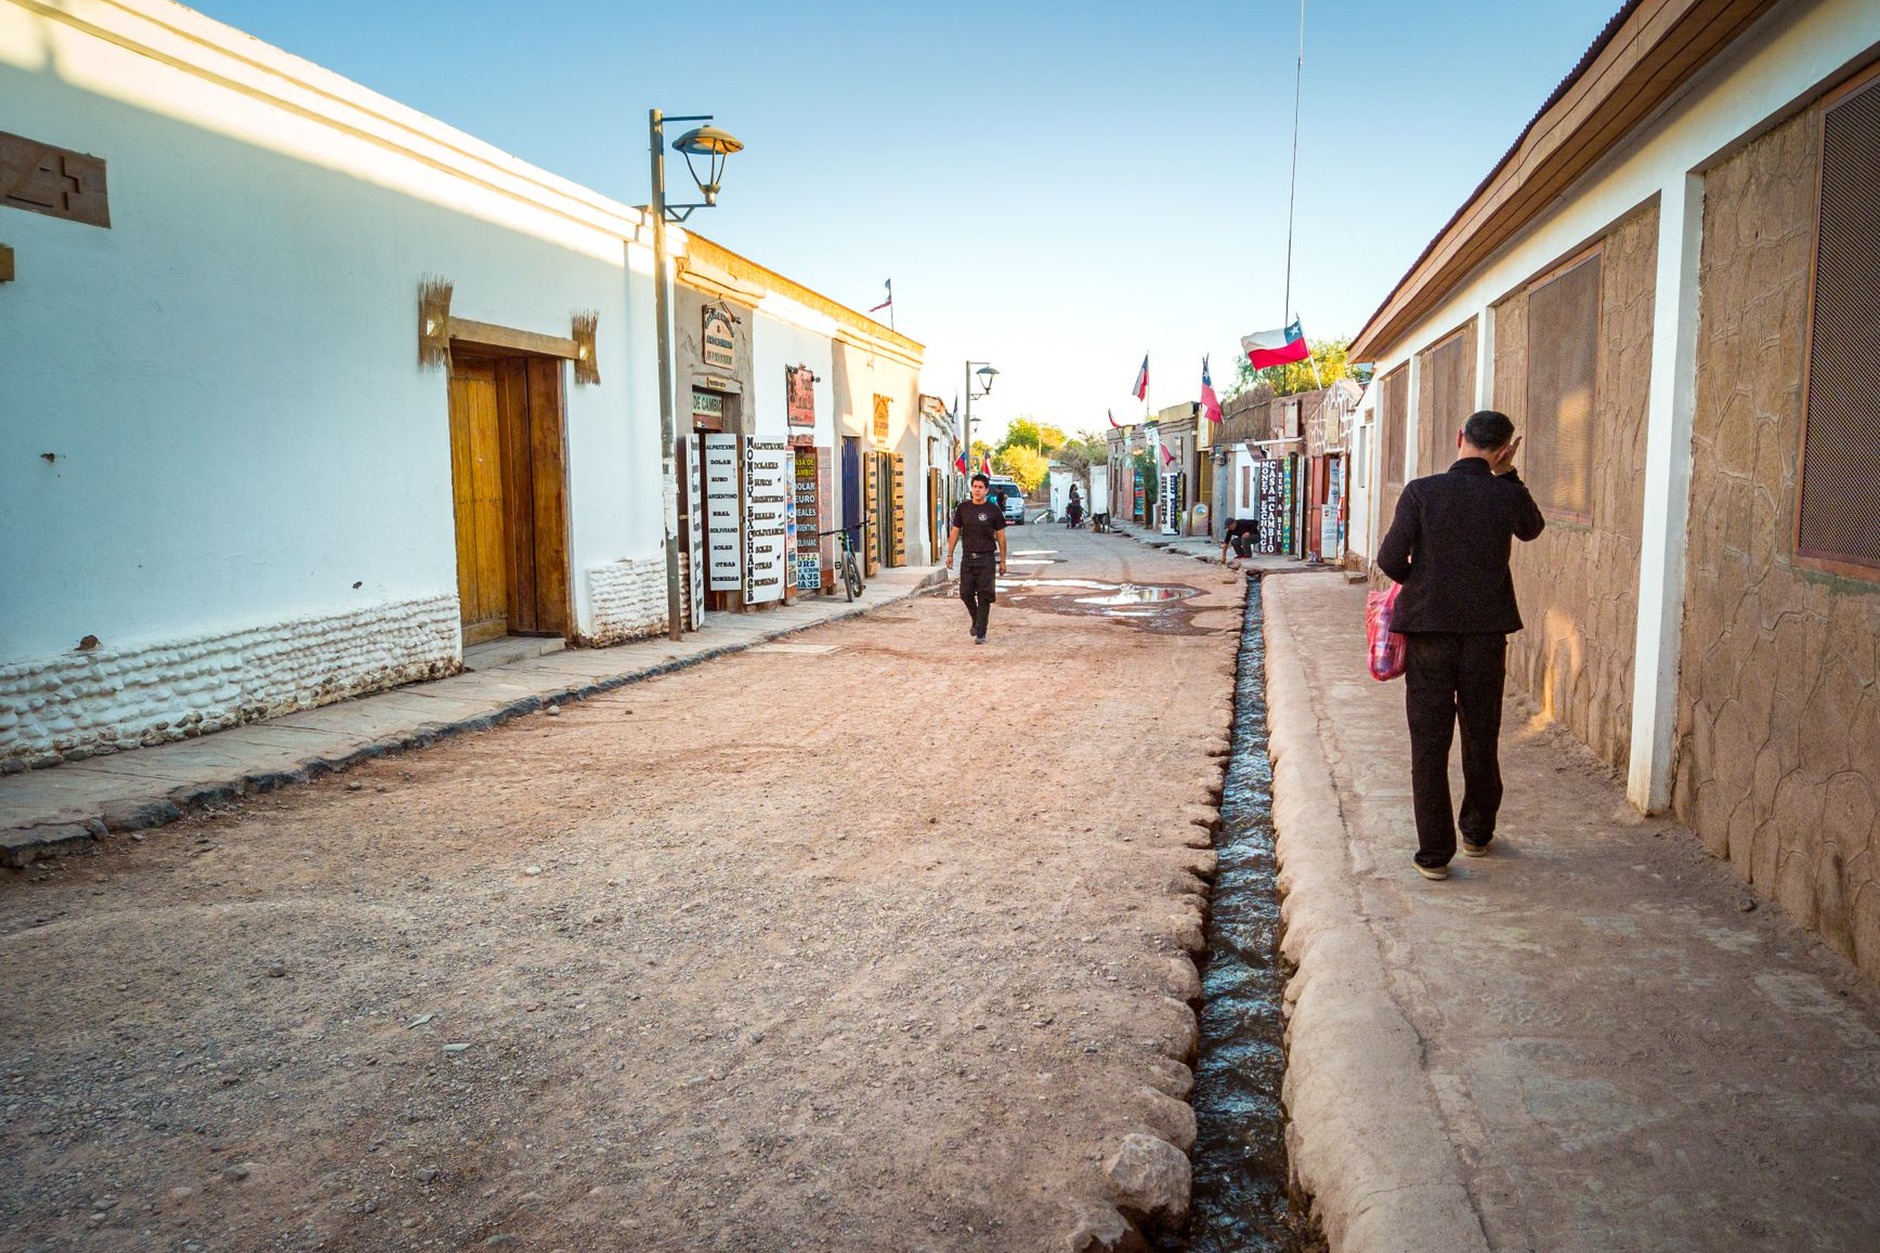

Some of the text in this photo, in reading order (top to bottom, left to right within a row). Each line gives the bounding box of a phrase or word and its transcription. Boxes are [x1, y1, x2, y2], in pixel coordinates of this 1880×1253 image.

[692, 394, 701, 410] DE
[1268, 461, 1276, 495] CASA
[796, 508, 816, 516] EALES
[1260, 461, 1269, 552] MONEY EXCHANGE
[1267, 504, 1276, 552] CAMBIO
[755, 545, 773, 554] SOLES
[754, 561, 773, 570] OTRAS
